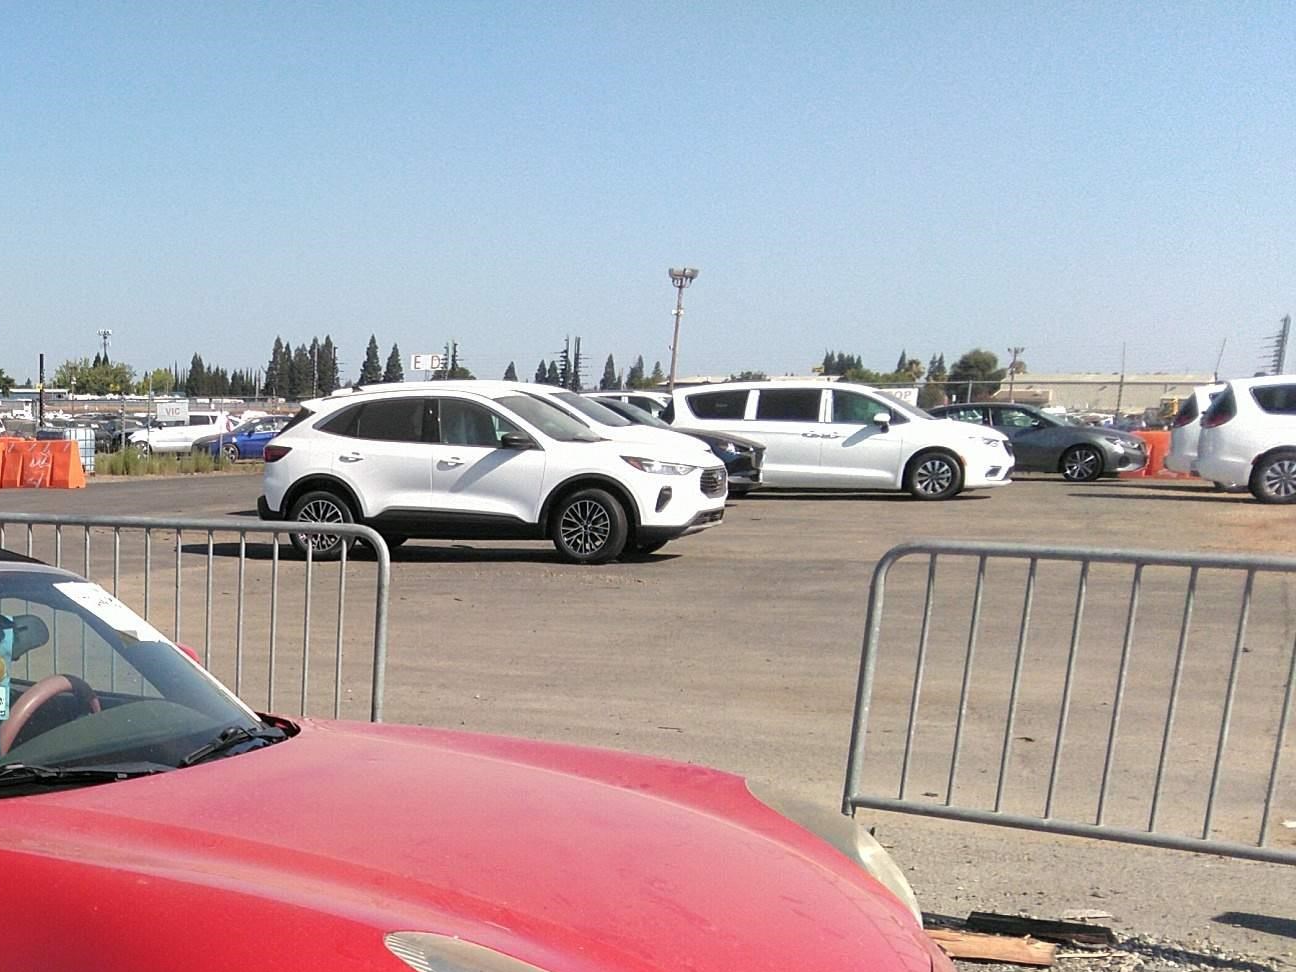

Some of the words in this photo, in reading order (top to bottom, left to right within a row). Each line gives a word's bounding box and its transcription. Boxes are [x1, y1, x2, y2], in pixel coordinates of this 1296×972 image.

[414, 355, 422, 370] E
[431, 355, 441, 370] D
[165, 407, 181, 416] VIC
